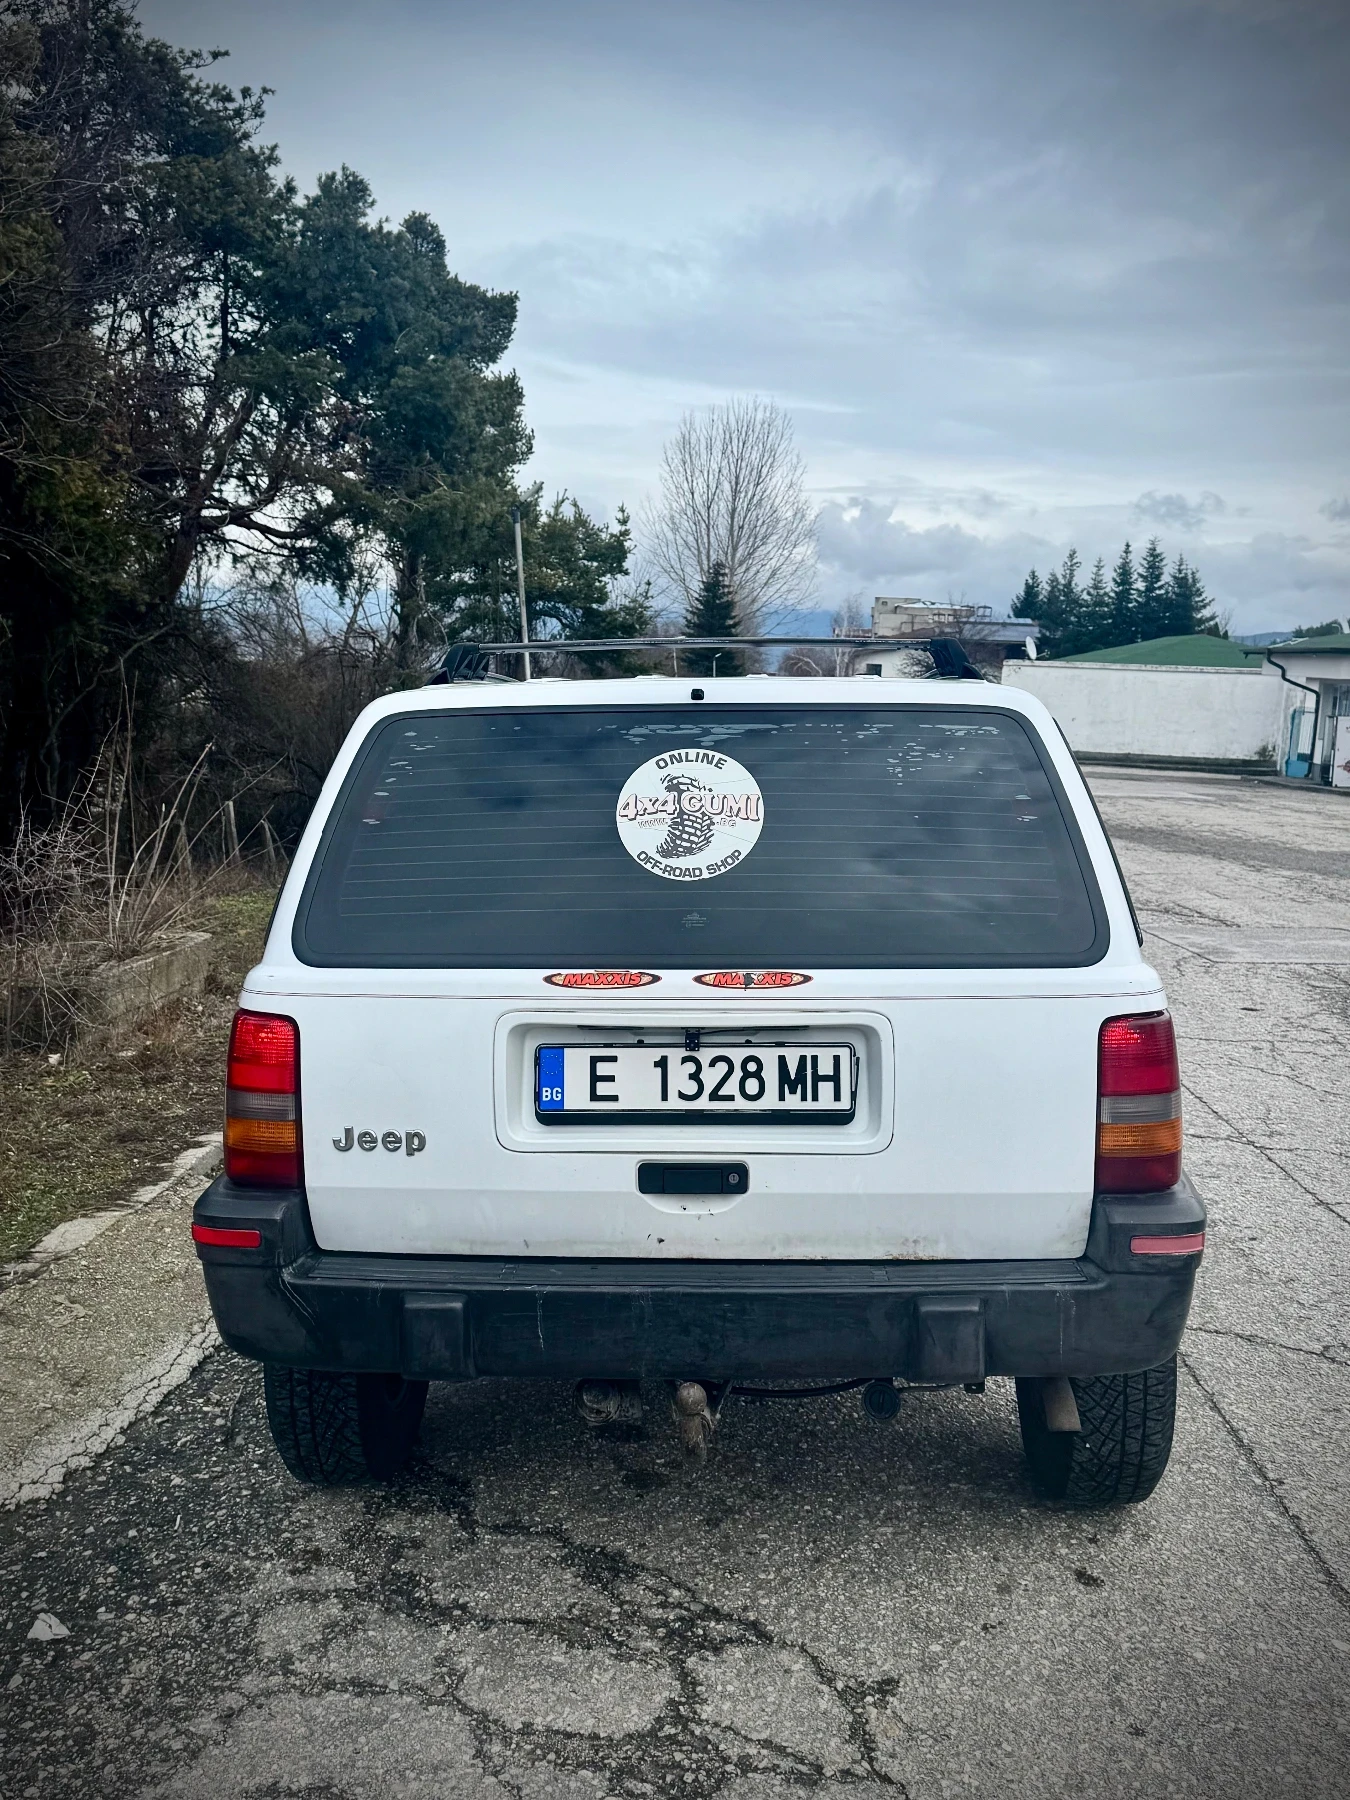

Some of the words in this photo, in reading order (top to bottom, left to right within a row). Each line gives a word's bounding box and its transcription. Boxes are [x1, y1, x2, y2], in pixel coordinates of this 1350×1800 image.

[655, 751, 728, 770] ONLINE
[618, 792, 679, 821] 4x4
[681, 792, 761, 822] GUMI
[636, 850, 703, 879] OFF-ROAD
[705, 849, 742, 875] SHOP
[562, 972, 642, 986] MAXXIS
[588, 1055, 620, 1102] E
[653, 1054, 766, 1102] 1328
[777, 1054, 841, 1102] MH
[541, 1087, 562, 1101] BG
[332, 1126, 427, 1157] Jeep
